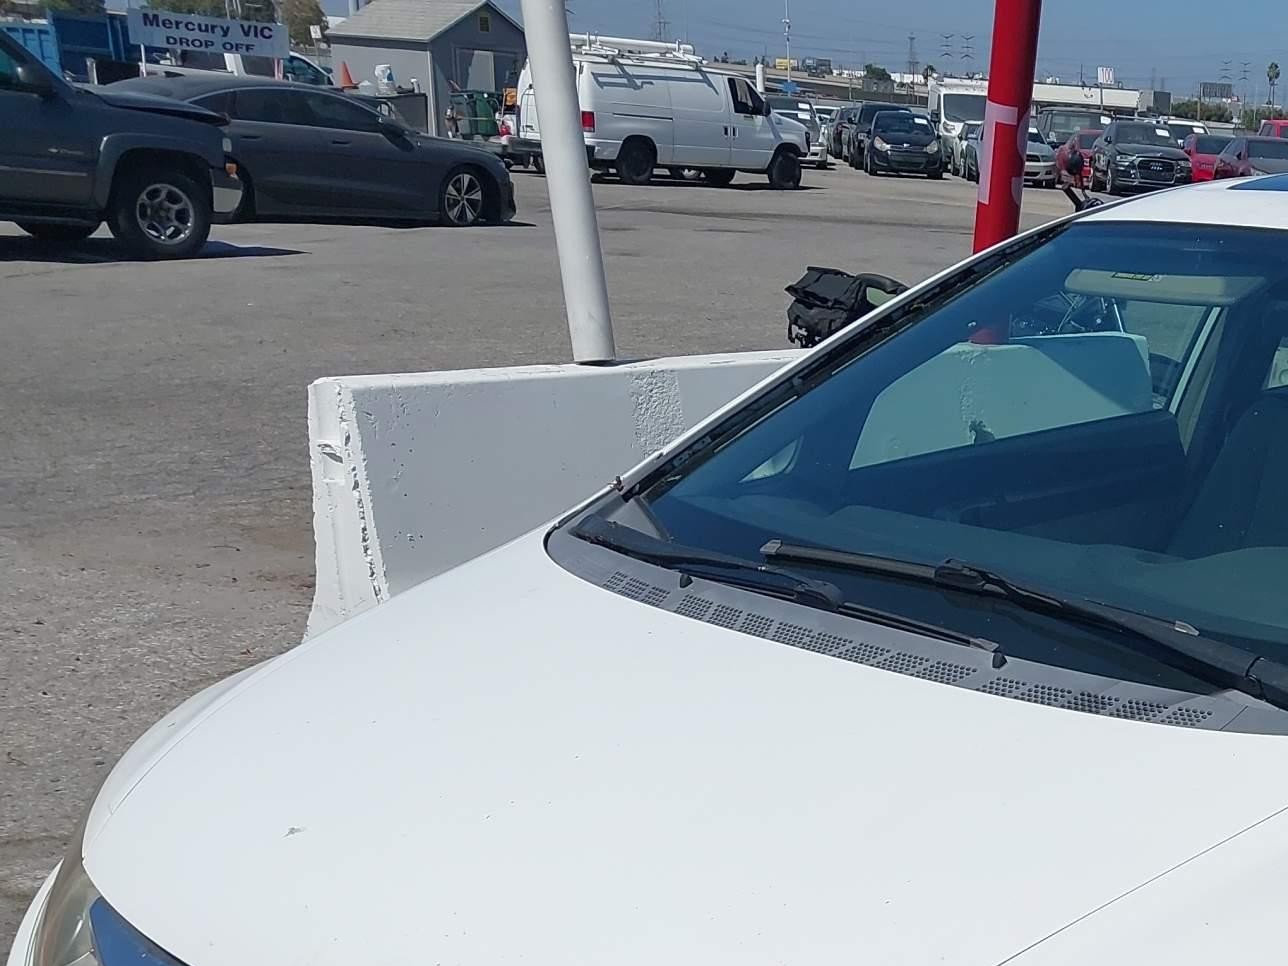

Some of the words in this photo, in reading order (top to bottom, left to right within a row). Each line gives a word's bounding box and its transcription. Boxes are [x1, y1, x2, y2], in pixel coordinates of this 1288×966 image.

[142, 12, 230, 38] Mercury
[239, 23, 273, 40] VIC
[166, 35, 215, 49] DROP
[222, 41, 256, 53] OFF
